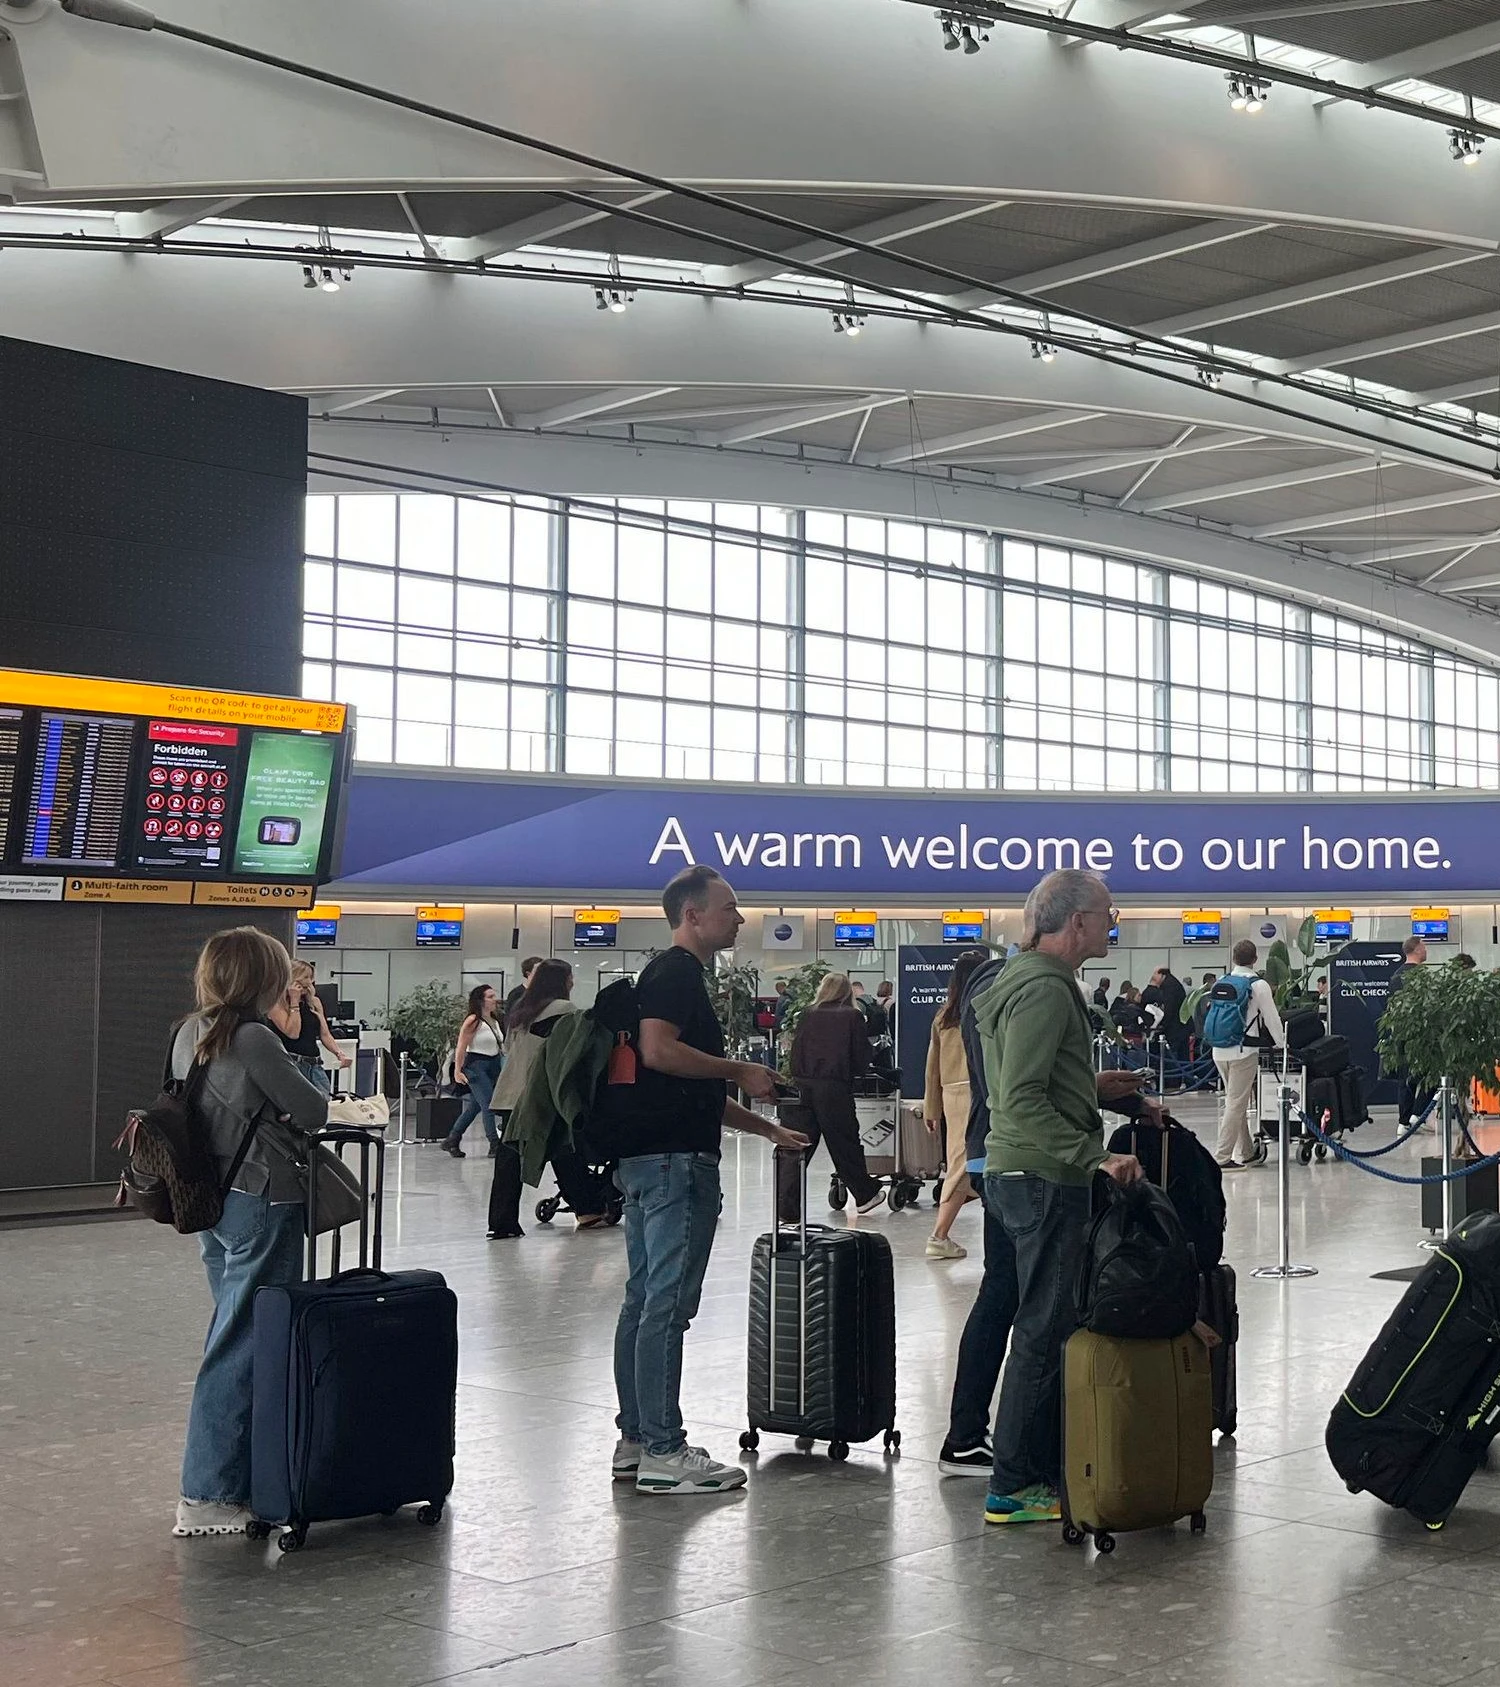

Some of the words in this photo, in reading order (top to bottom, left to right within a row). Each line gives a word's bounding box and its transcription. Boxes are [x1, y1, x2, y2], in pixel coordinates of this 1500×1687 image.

[170, 693, 192, 703] Scan
[194, 696, 210, 704] the
[211, 697, 226, 705] QR
[153, 743, 208, 757] Forbidden
[648, 816, 696, 865] A
[713, 831, 861, 868] warm
[881, 823, 1114, 871] welcome
[1131, 832, 1183, 871] to
[1201, 836, 1287, 871] our
[1303, 825, 1452, 870] home.
[85, 881, 139, 890] Multi-faith
[227, 886, 257, 894] Toilets
[910, 996, 934, 1004] CLUB
[1478, 1386, 1497, 1412] HIGH
